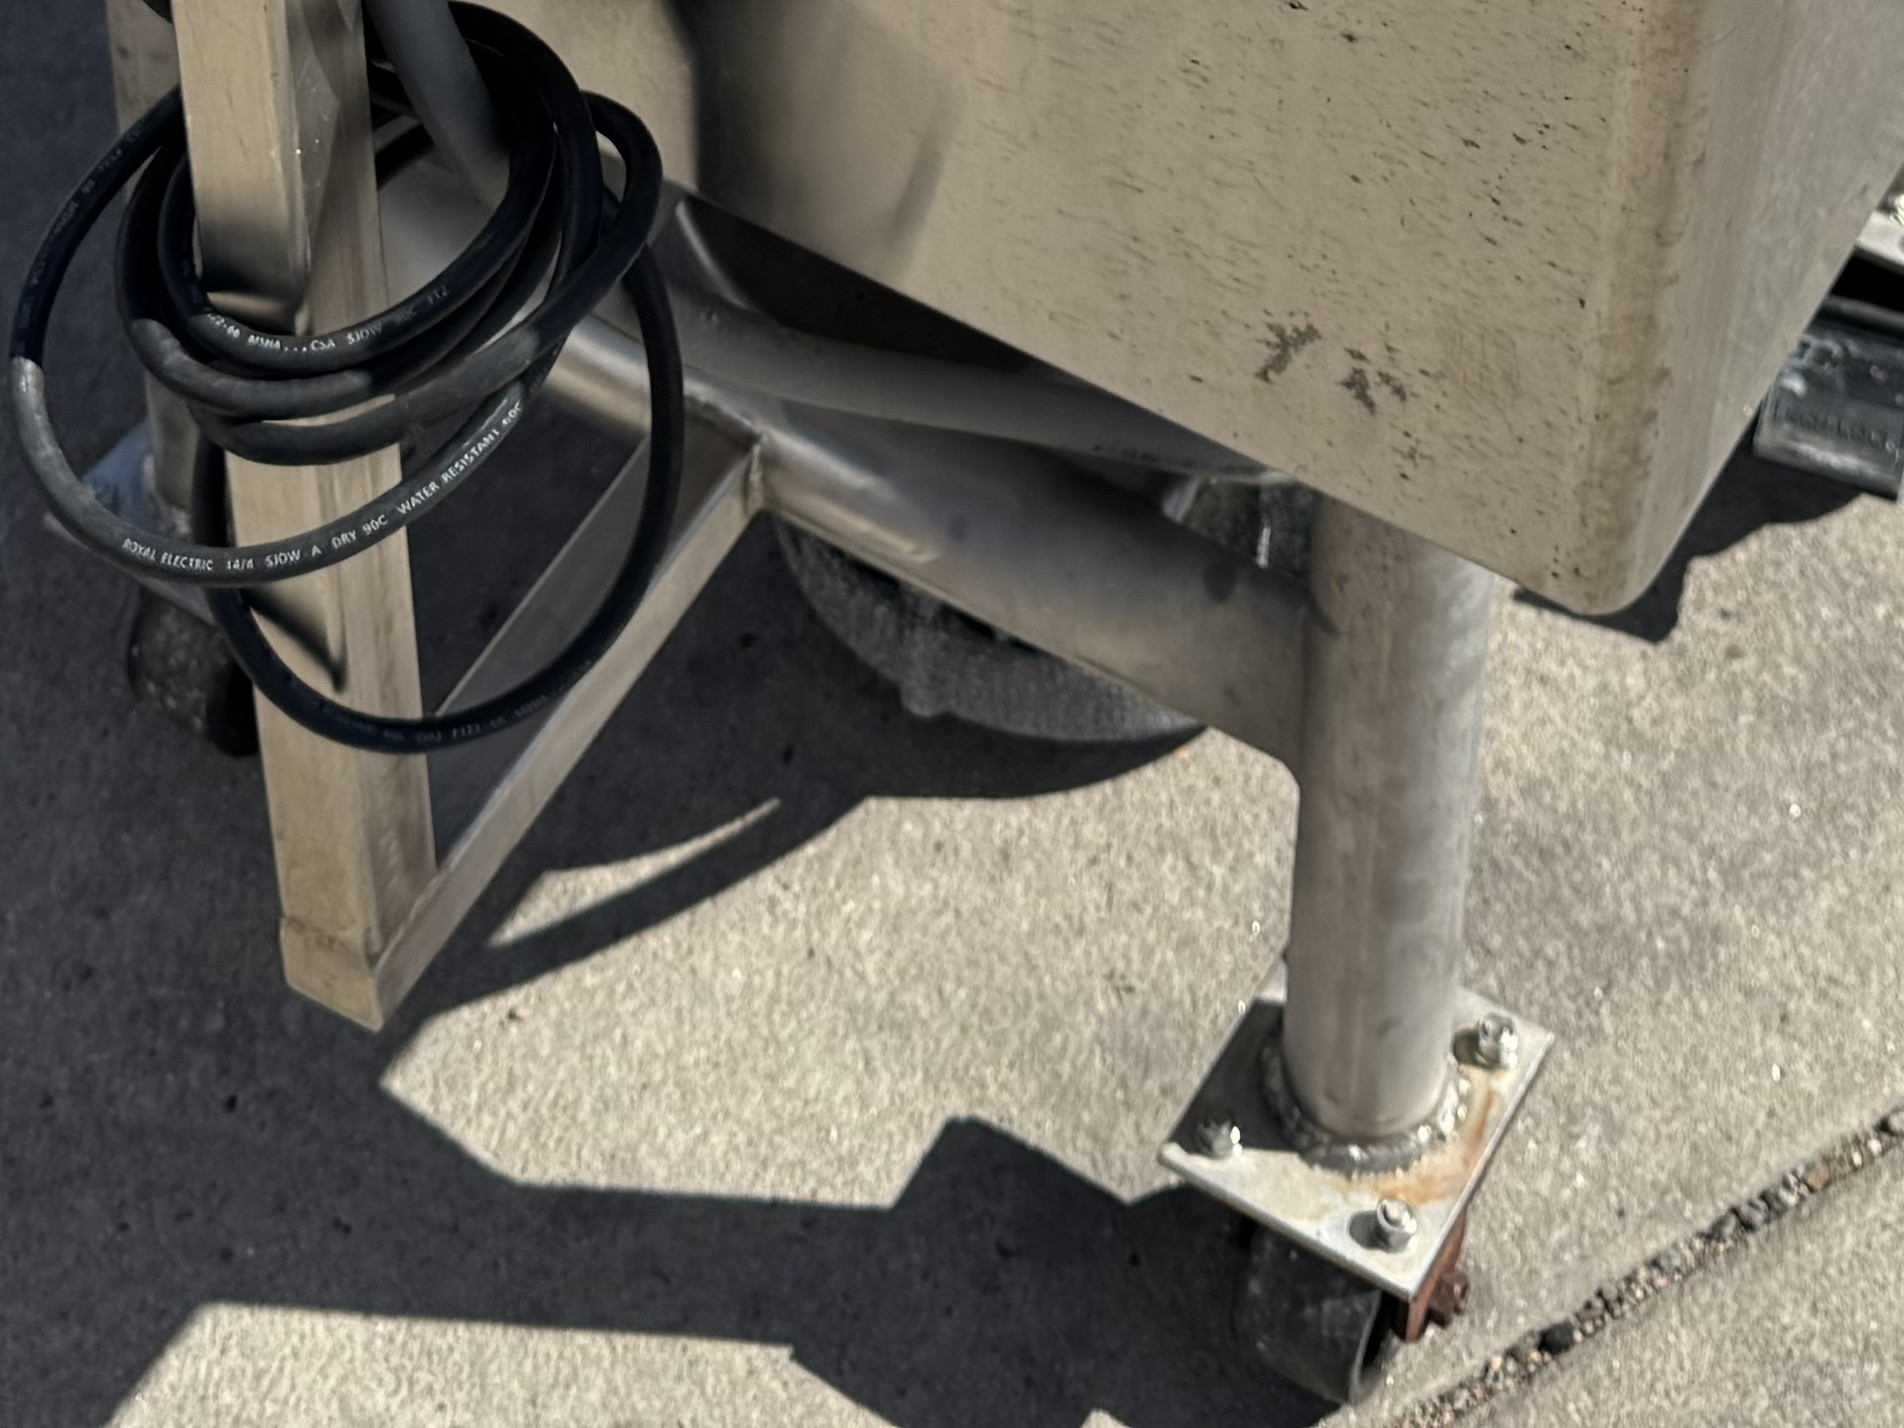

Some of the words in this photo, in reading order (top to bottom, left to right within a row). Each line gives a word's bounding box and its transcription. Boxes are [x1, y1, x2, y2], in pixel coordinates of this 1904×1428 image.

[122, 538, 156, 561] ROYAL
[160, 551, 214, 571] ELECTRIC
[331, 529, 357, 549] DRY
[362, 514, 388, 536] 90C
[396, 481, 440, 515] WATER
[441, 428, 500, 484] RESISTANT
